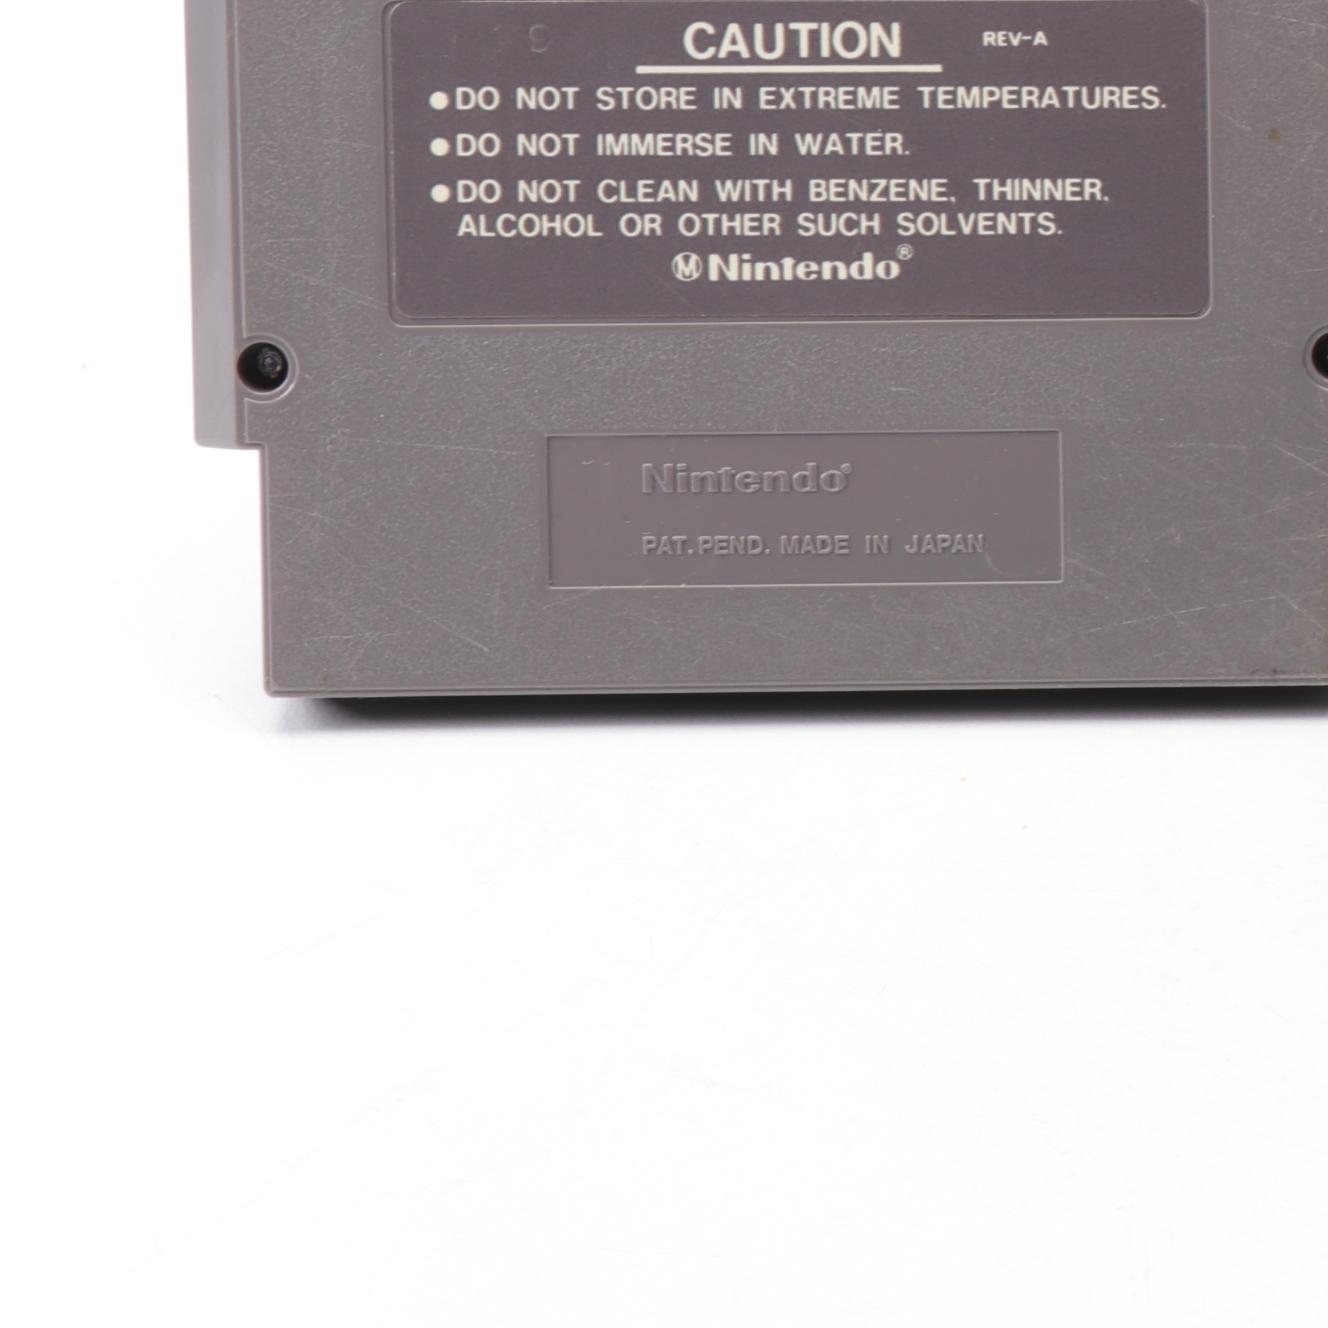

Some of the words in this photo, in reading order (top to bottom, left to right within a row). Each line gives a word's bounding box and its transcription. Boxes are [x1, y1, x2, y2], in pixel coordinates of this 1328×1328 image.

[683, 20, 901, 61] CAUTION
[982, 30, 1048, 47] REV-A
[455, 85, 501, 111] DO
[516, 86, 580, 111] NOT
[595, 85, 697, 111] STORE
[713, 86, 743, 110] IN
[759, 86, 900, 110] EXTREME
[916, 85, 1166, 110] TEMPERATURES.
[456, 132, 502, 158] DO
[516, 132, 581, 157] NOT
[596, 132, 733, 157] IMMERSE
[749, 132, 779, 156] IN
[794, 132, 910, 156] WATER.
[456, 178, 502, 204] DO
[517, 178, 581, 204] NOT
[597, 178, 699, 204] CLEAN
[714, 178, 793, 202] WITH
[457, 212, 604, 238] ALCOHOL
[619, 212, 662, 237] OR
[677, 212, 781, 237] OTHER
[797, 211, 881, 237] SUCH
[896, 211, 1063, 237] SOLVENTS.
[780, 534, 849, 555] MADE
[864, 533, 889, 555] IN
[904, 532, 985, 554] JAPAN
